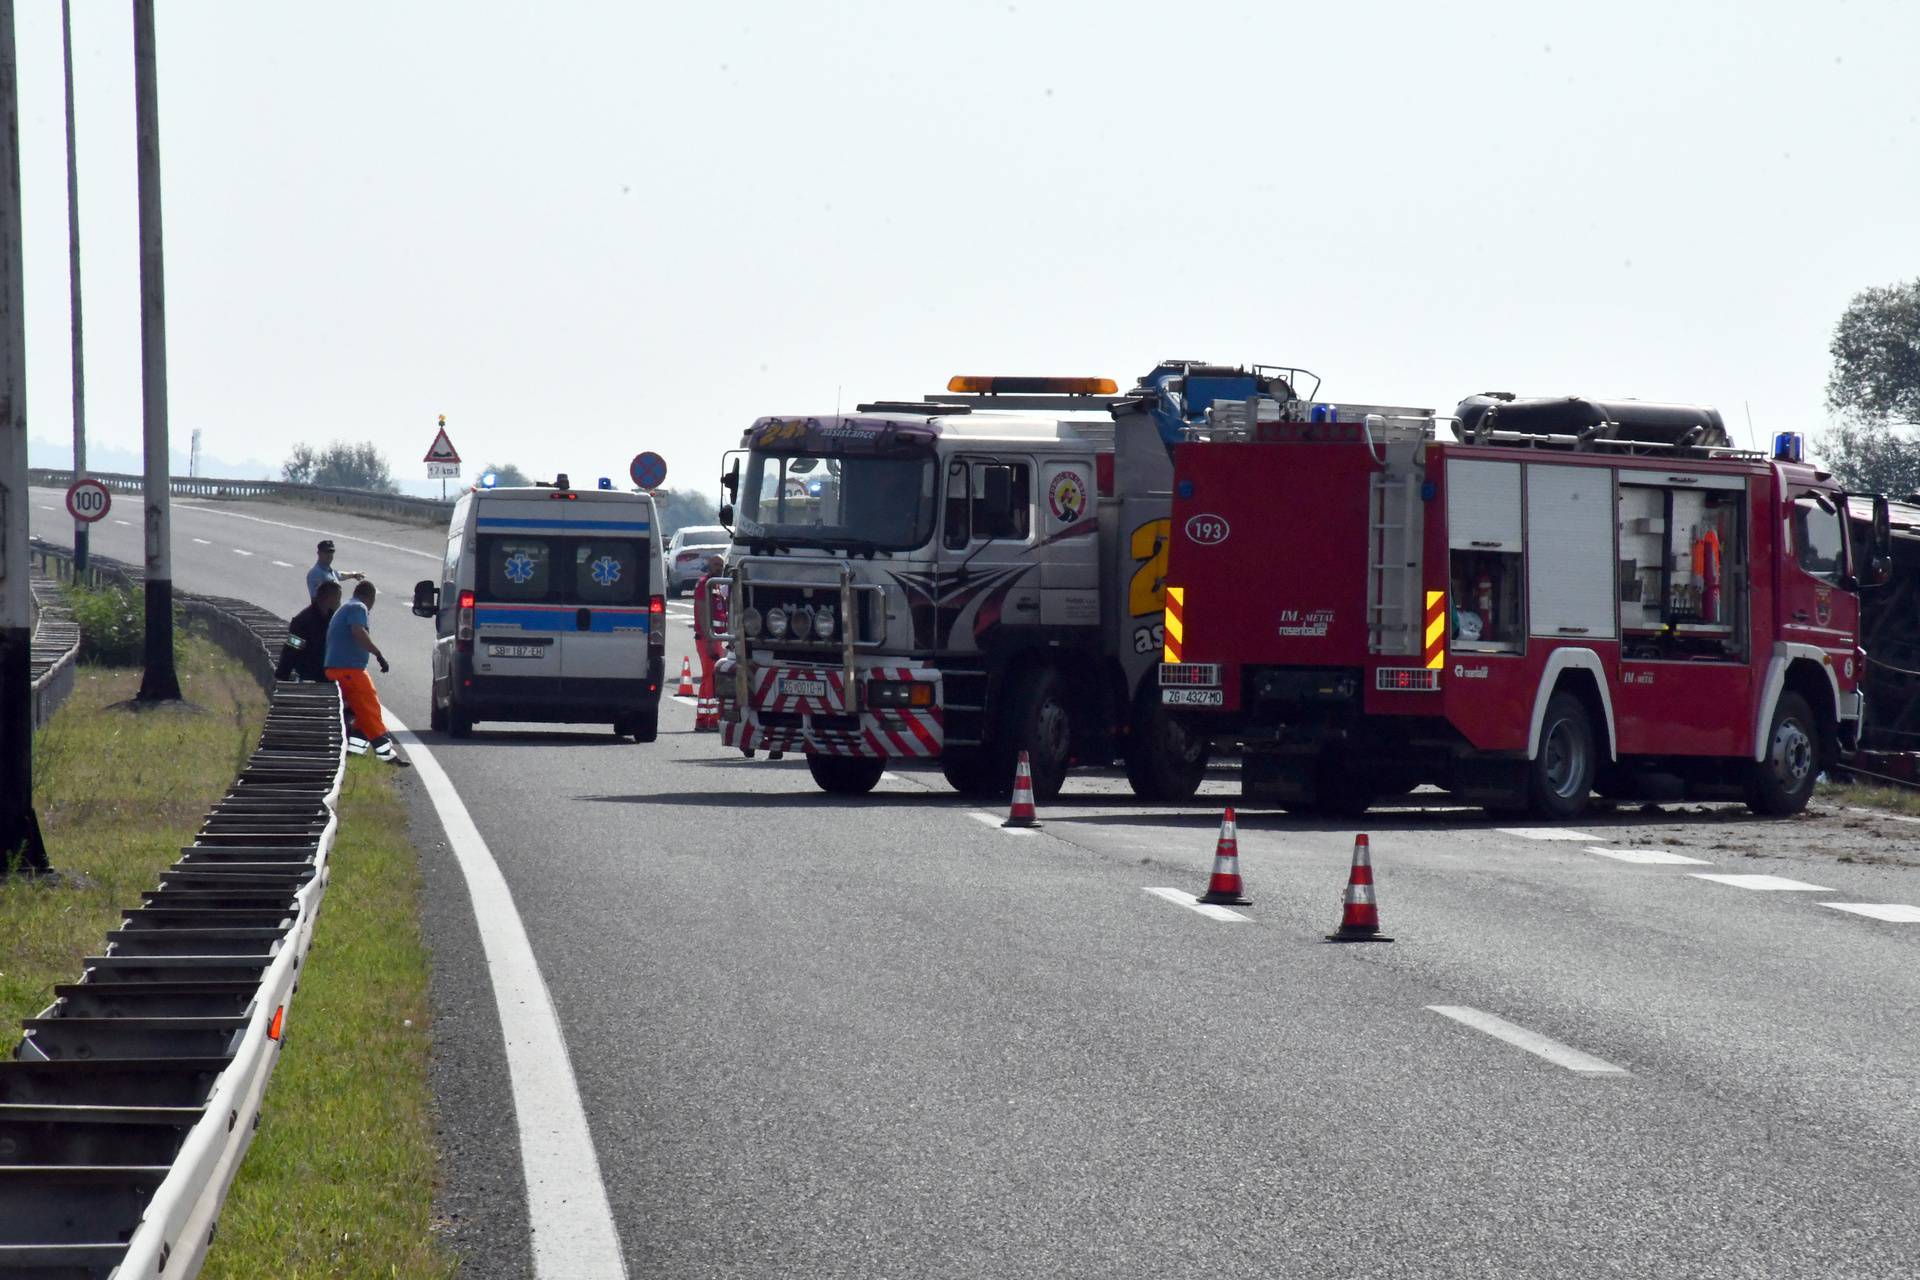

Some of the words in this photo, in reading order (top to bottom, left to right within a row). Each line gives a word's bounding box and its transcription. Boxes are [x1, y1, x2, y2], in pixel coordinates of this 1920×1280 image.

[820, 427, 876, 440] assistance
[76, 492, 102, 511] 100
[1196, 523, 1221, 539] 193
[1280, 610, 1298, 622] IM
[1305, 613, 1336, 623] METAL
[1168, 691, 1180, 703] ZG
[1186, 691, 1222, 704] 4327-MO
